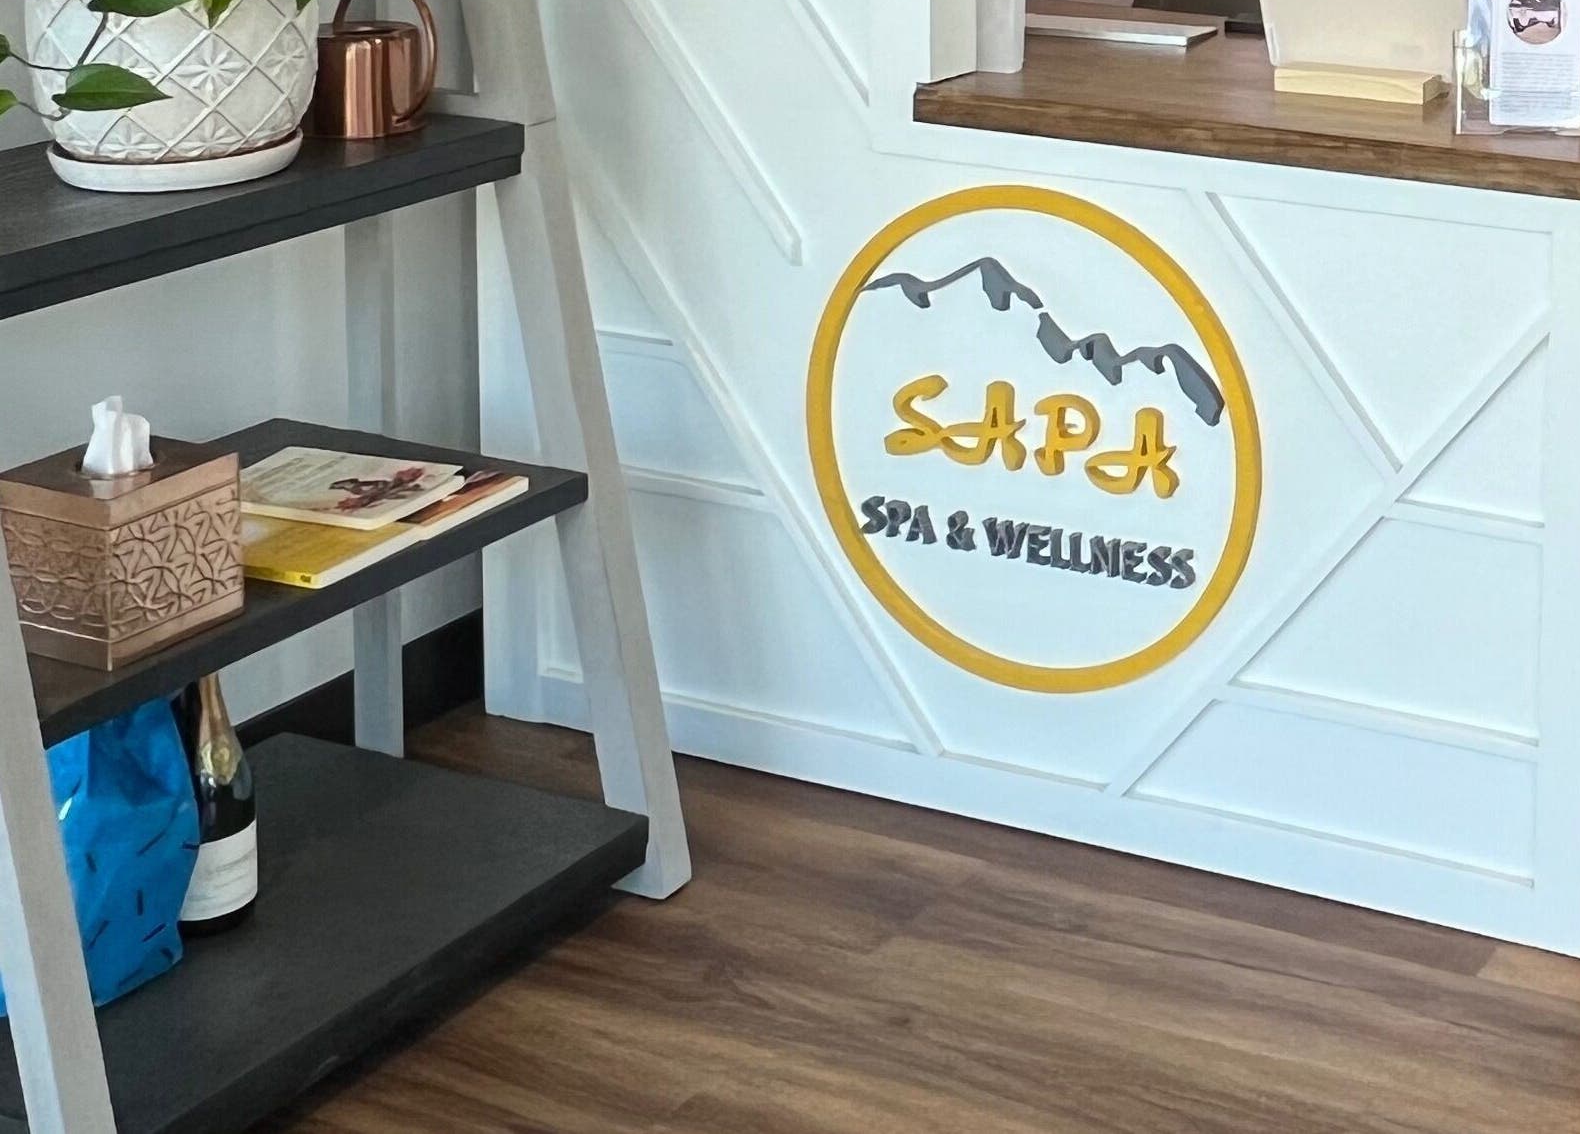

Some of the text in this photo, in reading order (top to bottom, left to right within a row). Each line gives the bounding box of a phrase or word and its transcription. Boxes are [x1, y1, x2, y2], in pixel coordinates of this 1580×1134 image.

[884, 374, 1181, 499] SAPA
[861, 495, 1197, 590] SPA & WELLNESS
